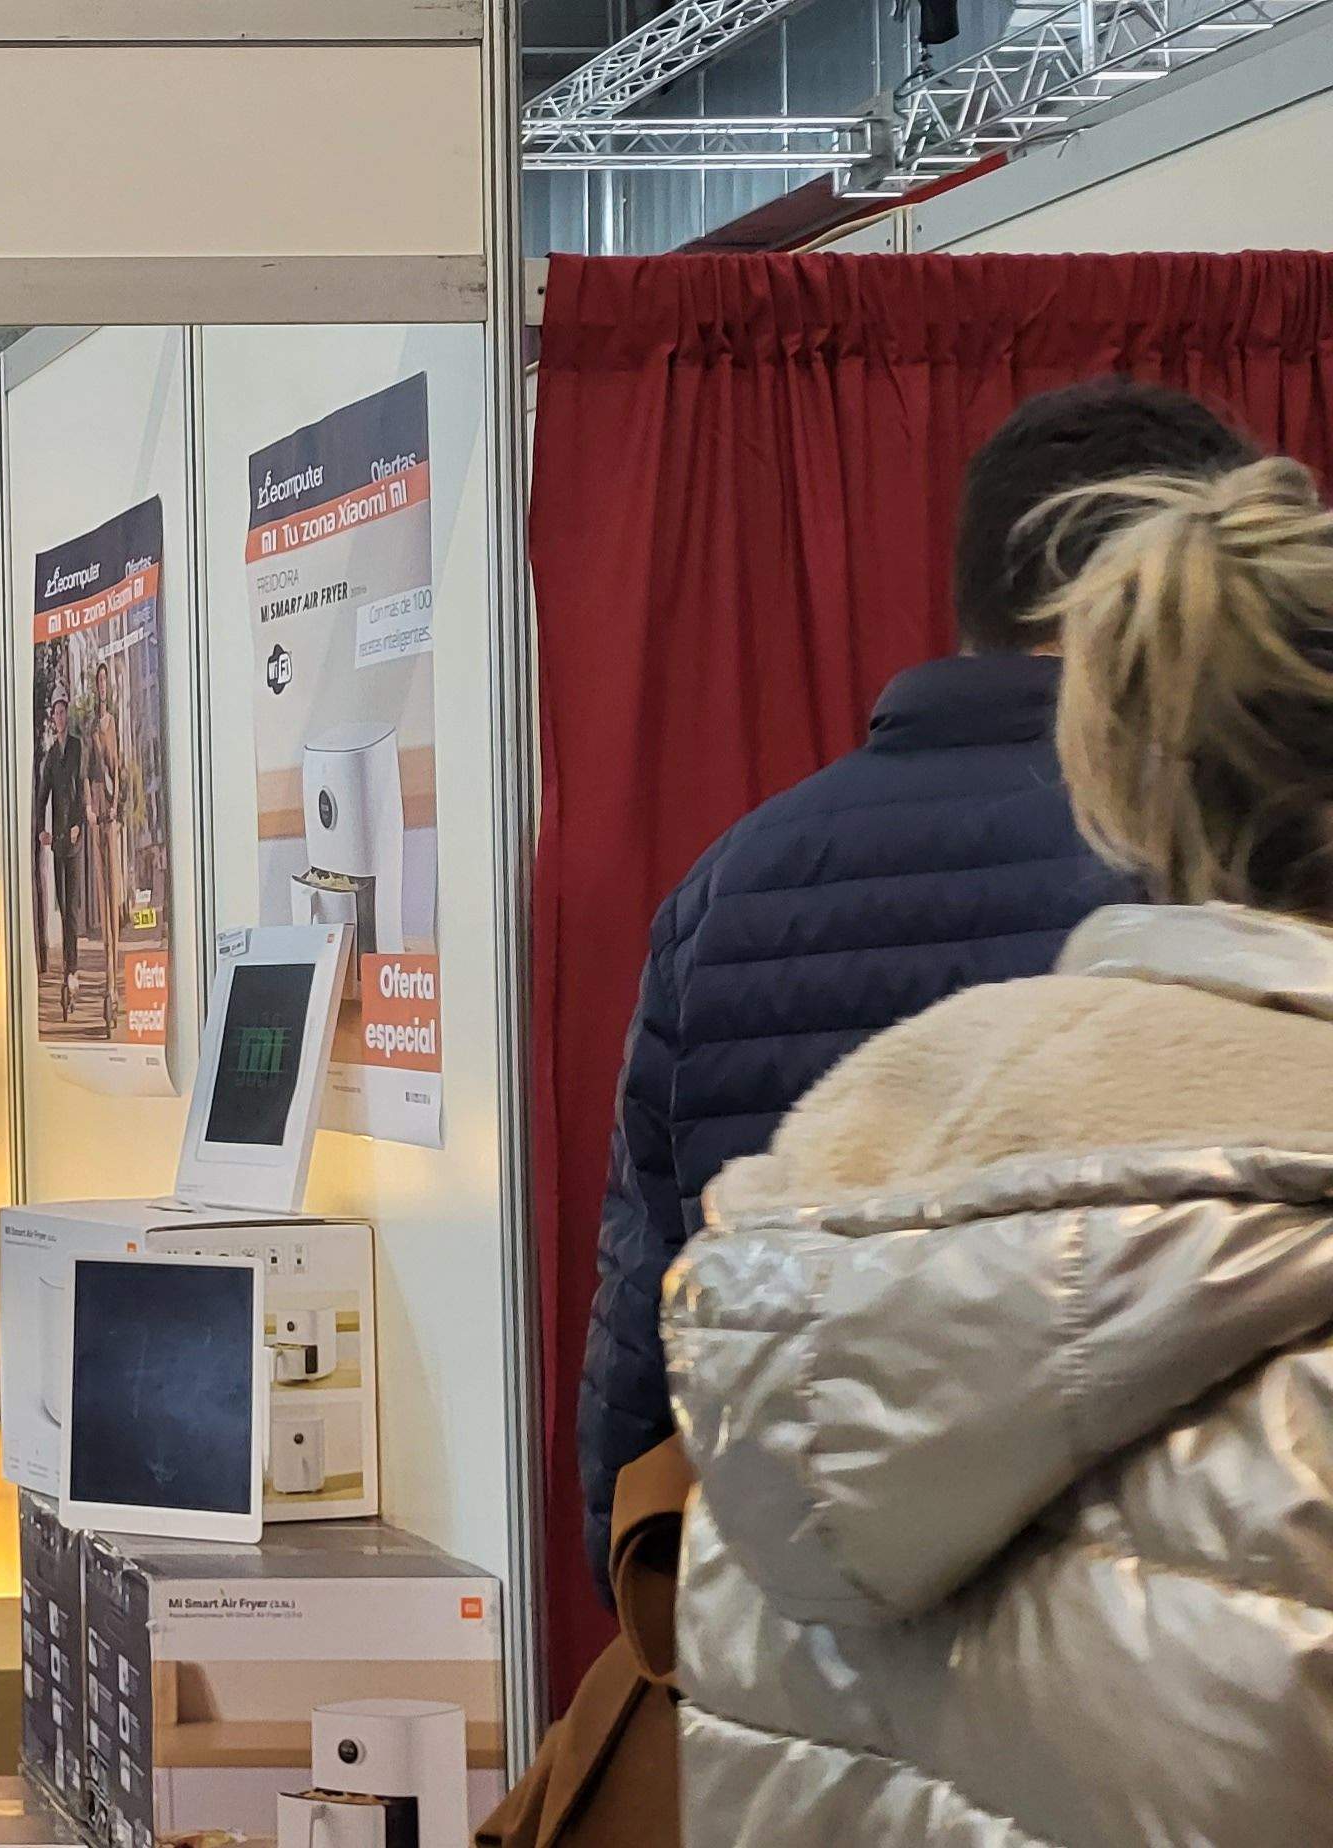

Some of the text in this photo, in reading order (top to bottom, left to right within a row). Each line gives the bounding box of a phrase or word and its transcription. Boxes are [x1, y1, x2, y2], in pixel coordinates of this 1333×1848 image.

[270, 465, 324, 502] ecomputer
[283, 523, 299, 548] Tu
[302, 511, 335, 542] zona
[338, 485, 387, 528] Xiaomi
[58, 562, 100, 592] ecomputer
[64, 608, 81, 629] Tu
[83, 600, 106, 624] zona
[271, 595, 302, 620] SMART
[303, 591, 319, 611] AIR
[321, 581, 348, 607] FRYER
[413, 588, 432, 611] 100
[135, 960, 165, 989] Oferta
[380, 963, 435, 1000] Oferta
[365, 1017, 436, 1058] especial
[184, 1598, 218, 1608] Smart
[221, 1598, 237, 1608] Air
[239, 1598, 268, 1611] Fryer
